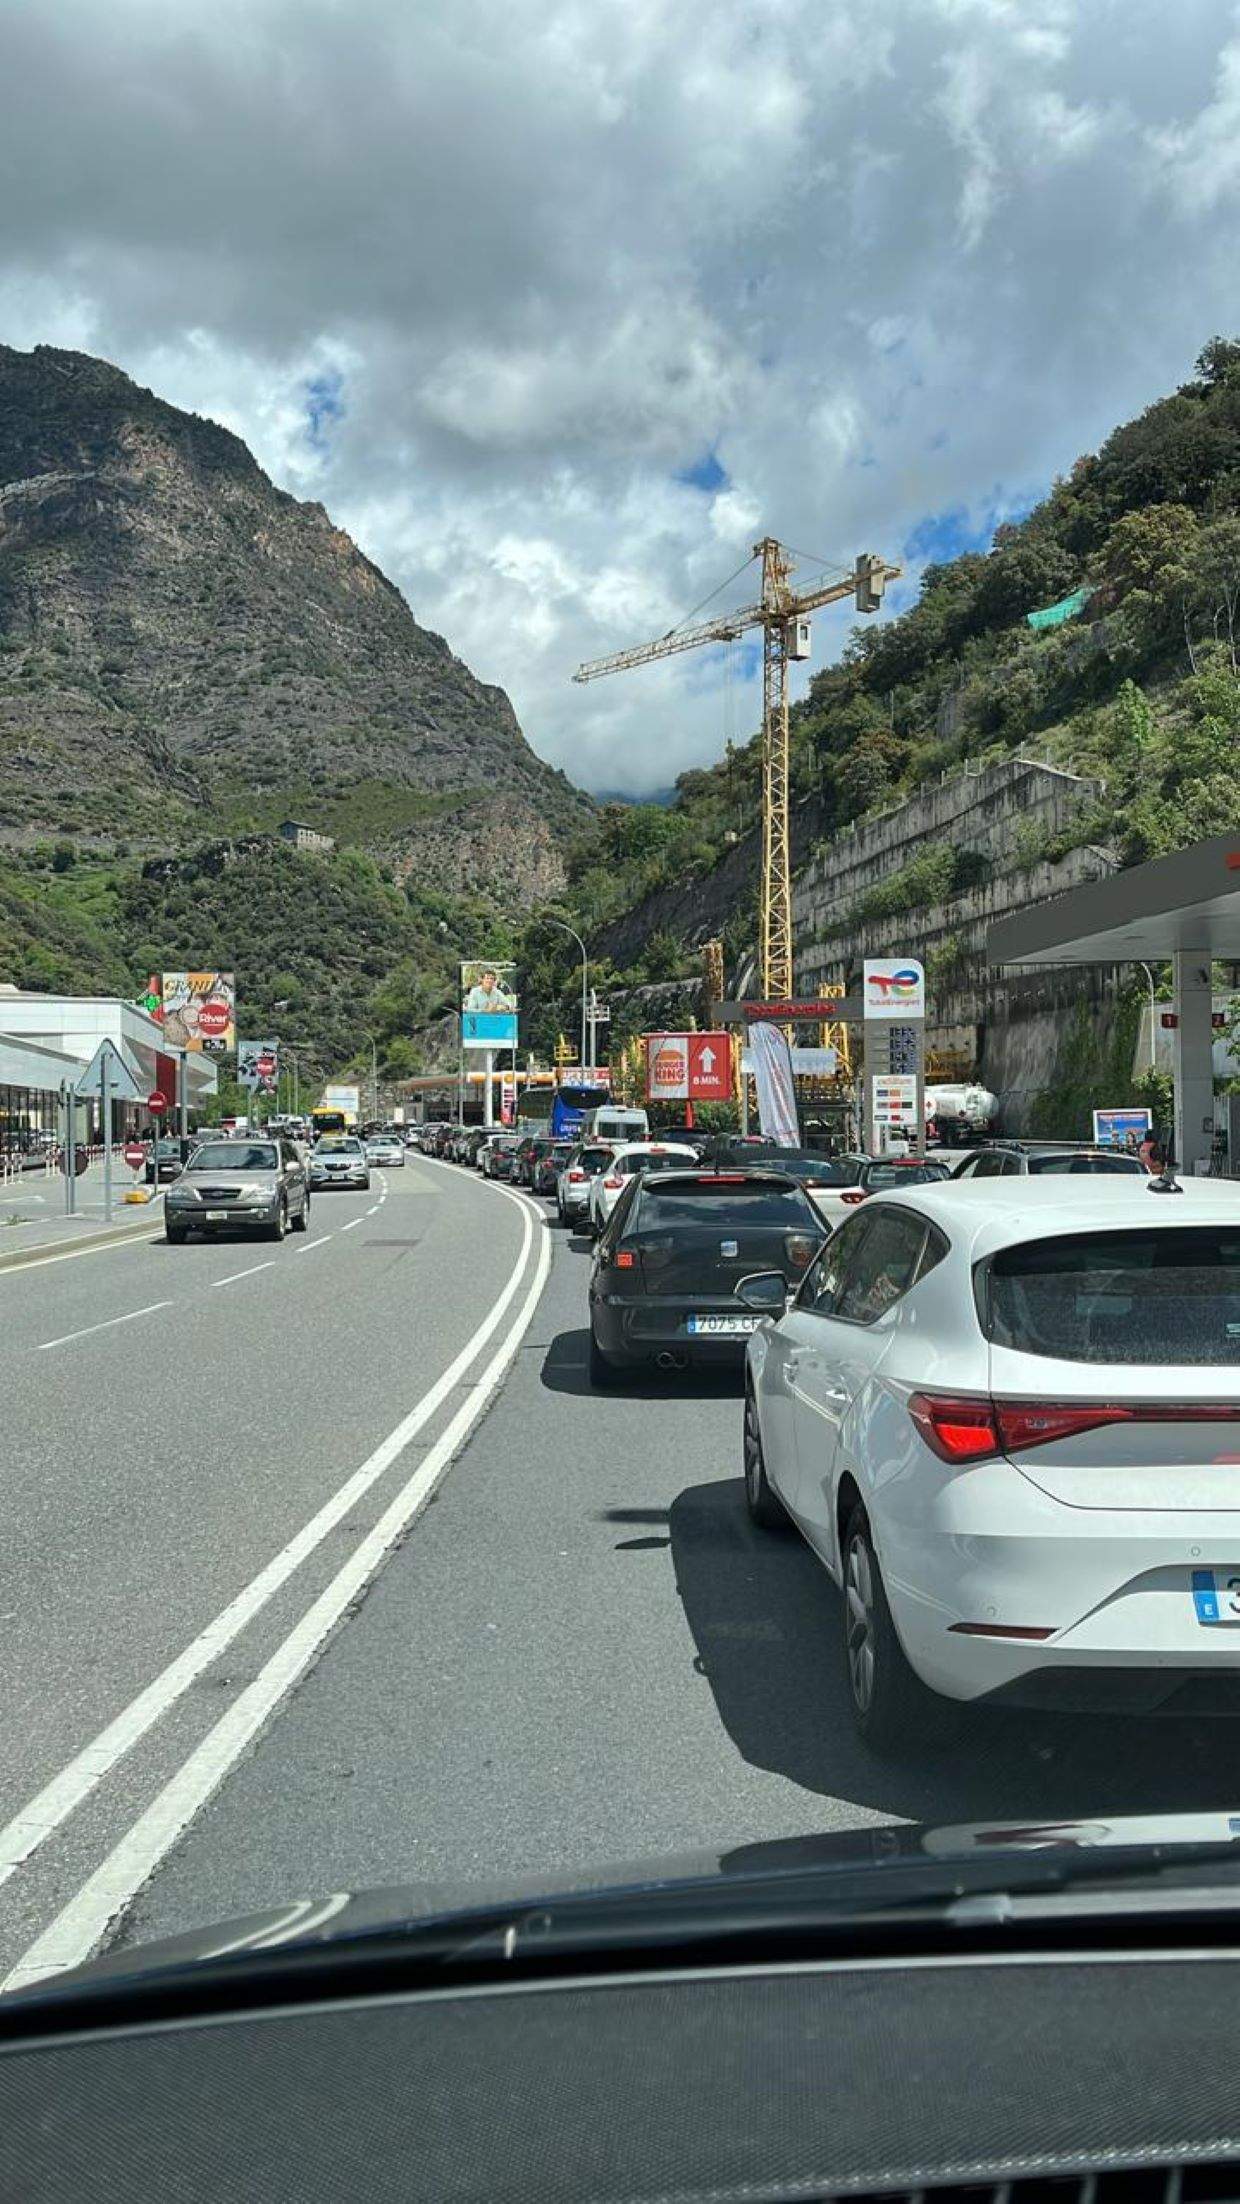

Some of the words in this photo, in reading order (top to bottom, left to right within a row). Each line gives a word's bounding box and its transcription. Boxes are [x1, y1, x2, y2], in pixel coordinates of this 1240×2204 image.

[199, 1012, 228, 1024] River
[699, 1316, 736, 1330] 7075
[1204, 1604, 1213, 1616] E
